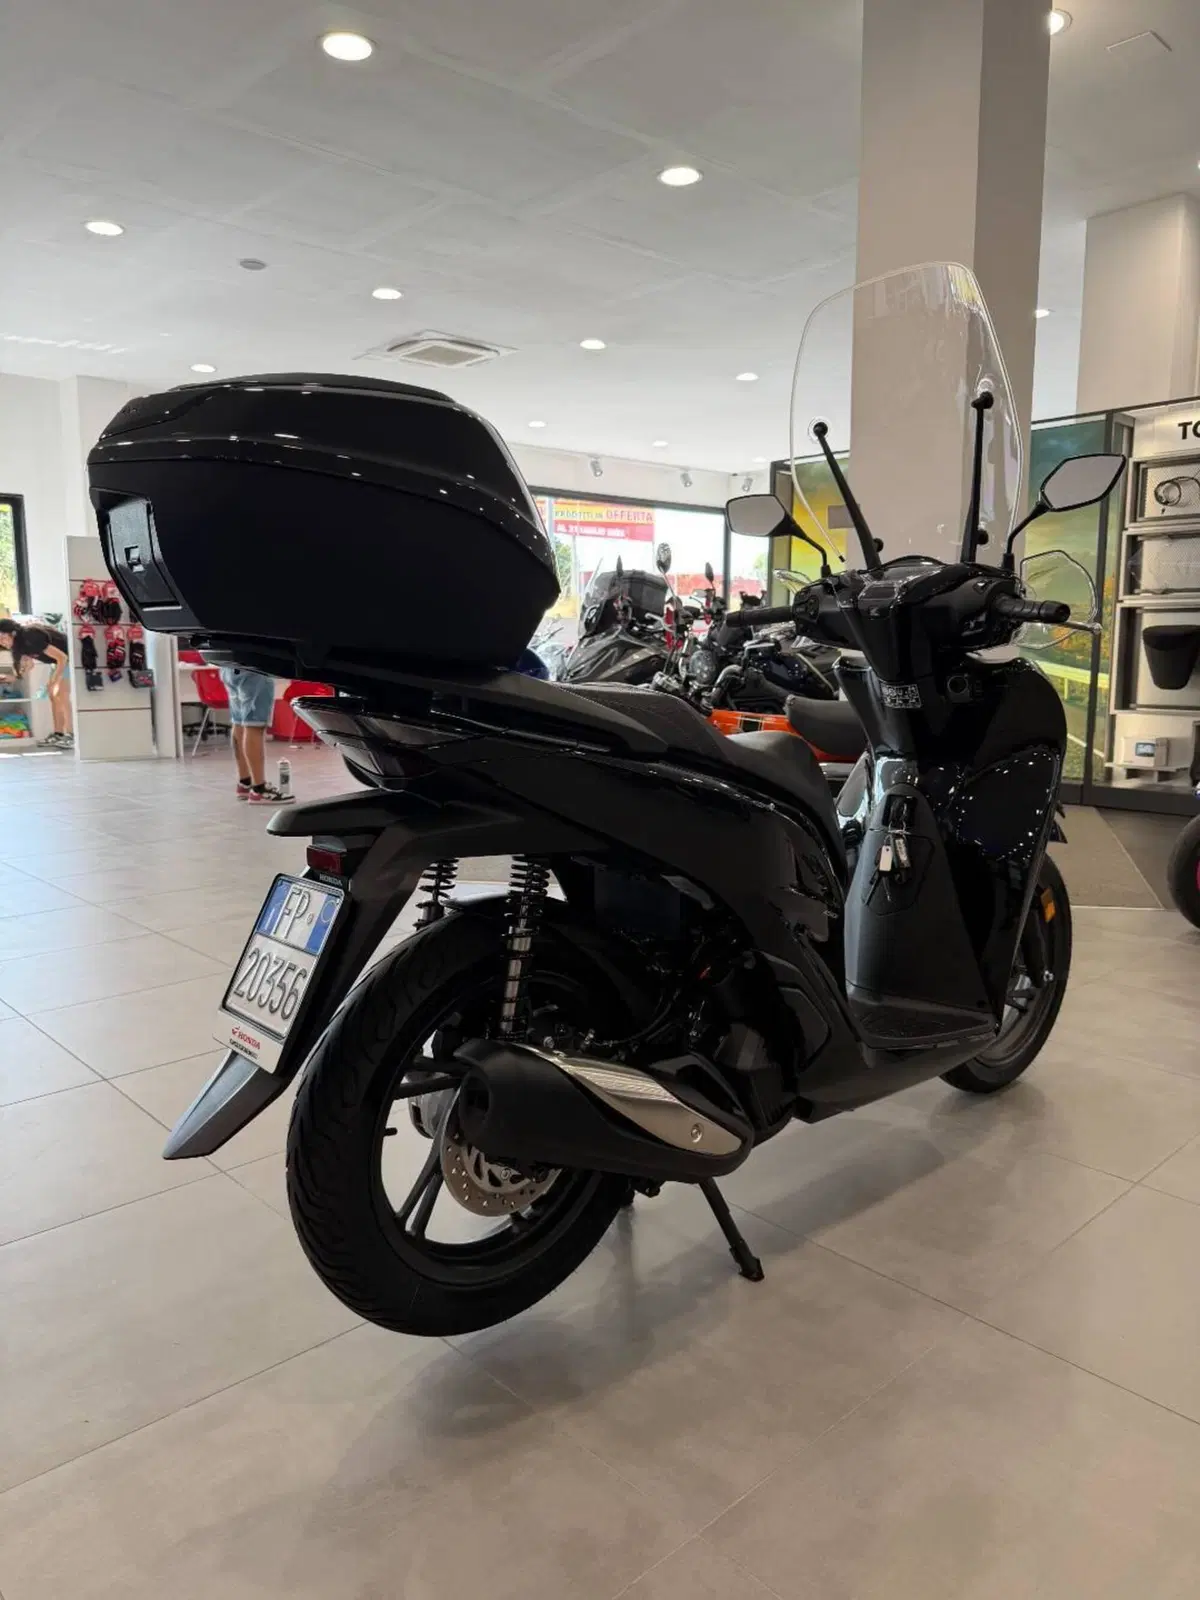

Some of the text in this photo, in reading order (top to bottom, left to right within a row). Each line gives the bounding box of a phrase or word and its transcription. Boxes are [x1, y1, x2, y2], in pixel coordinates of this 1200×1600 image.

[606, 509, 653, 521] OFFERTA
[319, 873, 343, 887] HONDA
[233, 947, 307, 1020] 20356
[238, 1031, 261, 1050] HONDA
